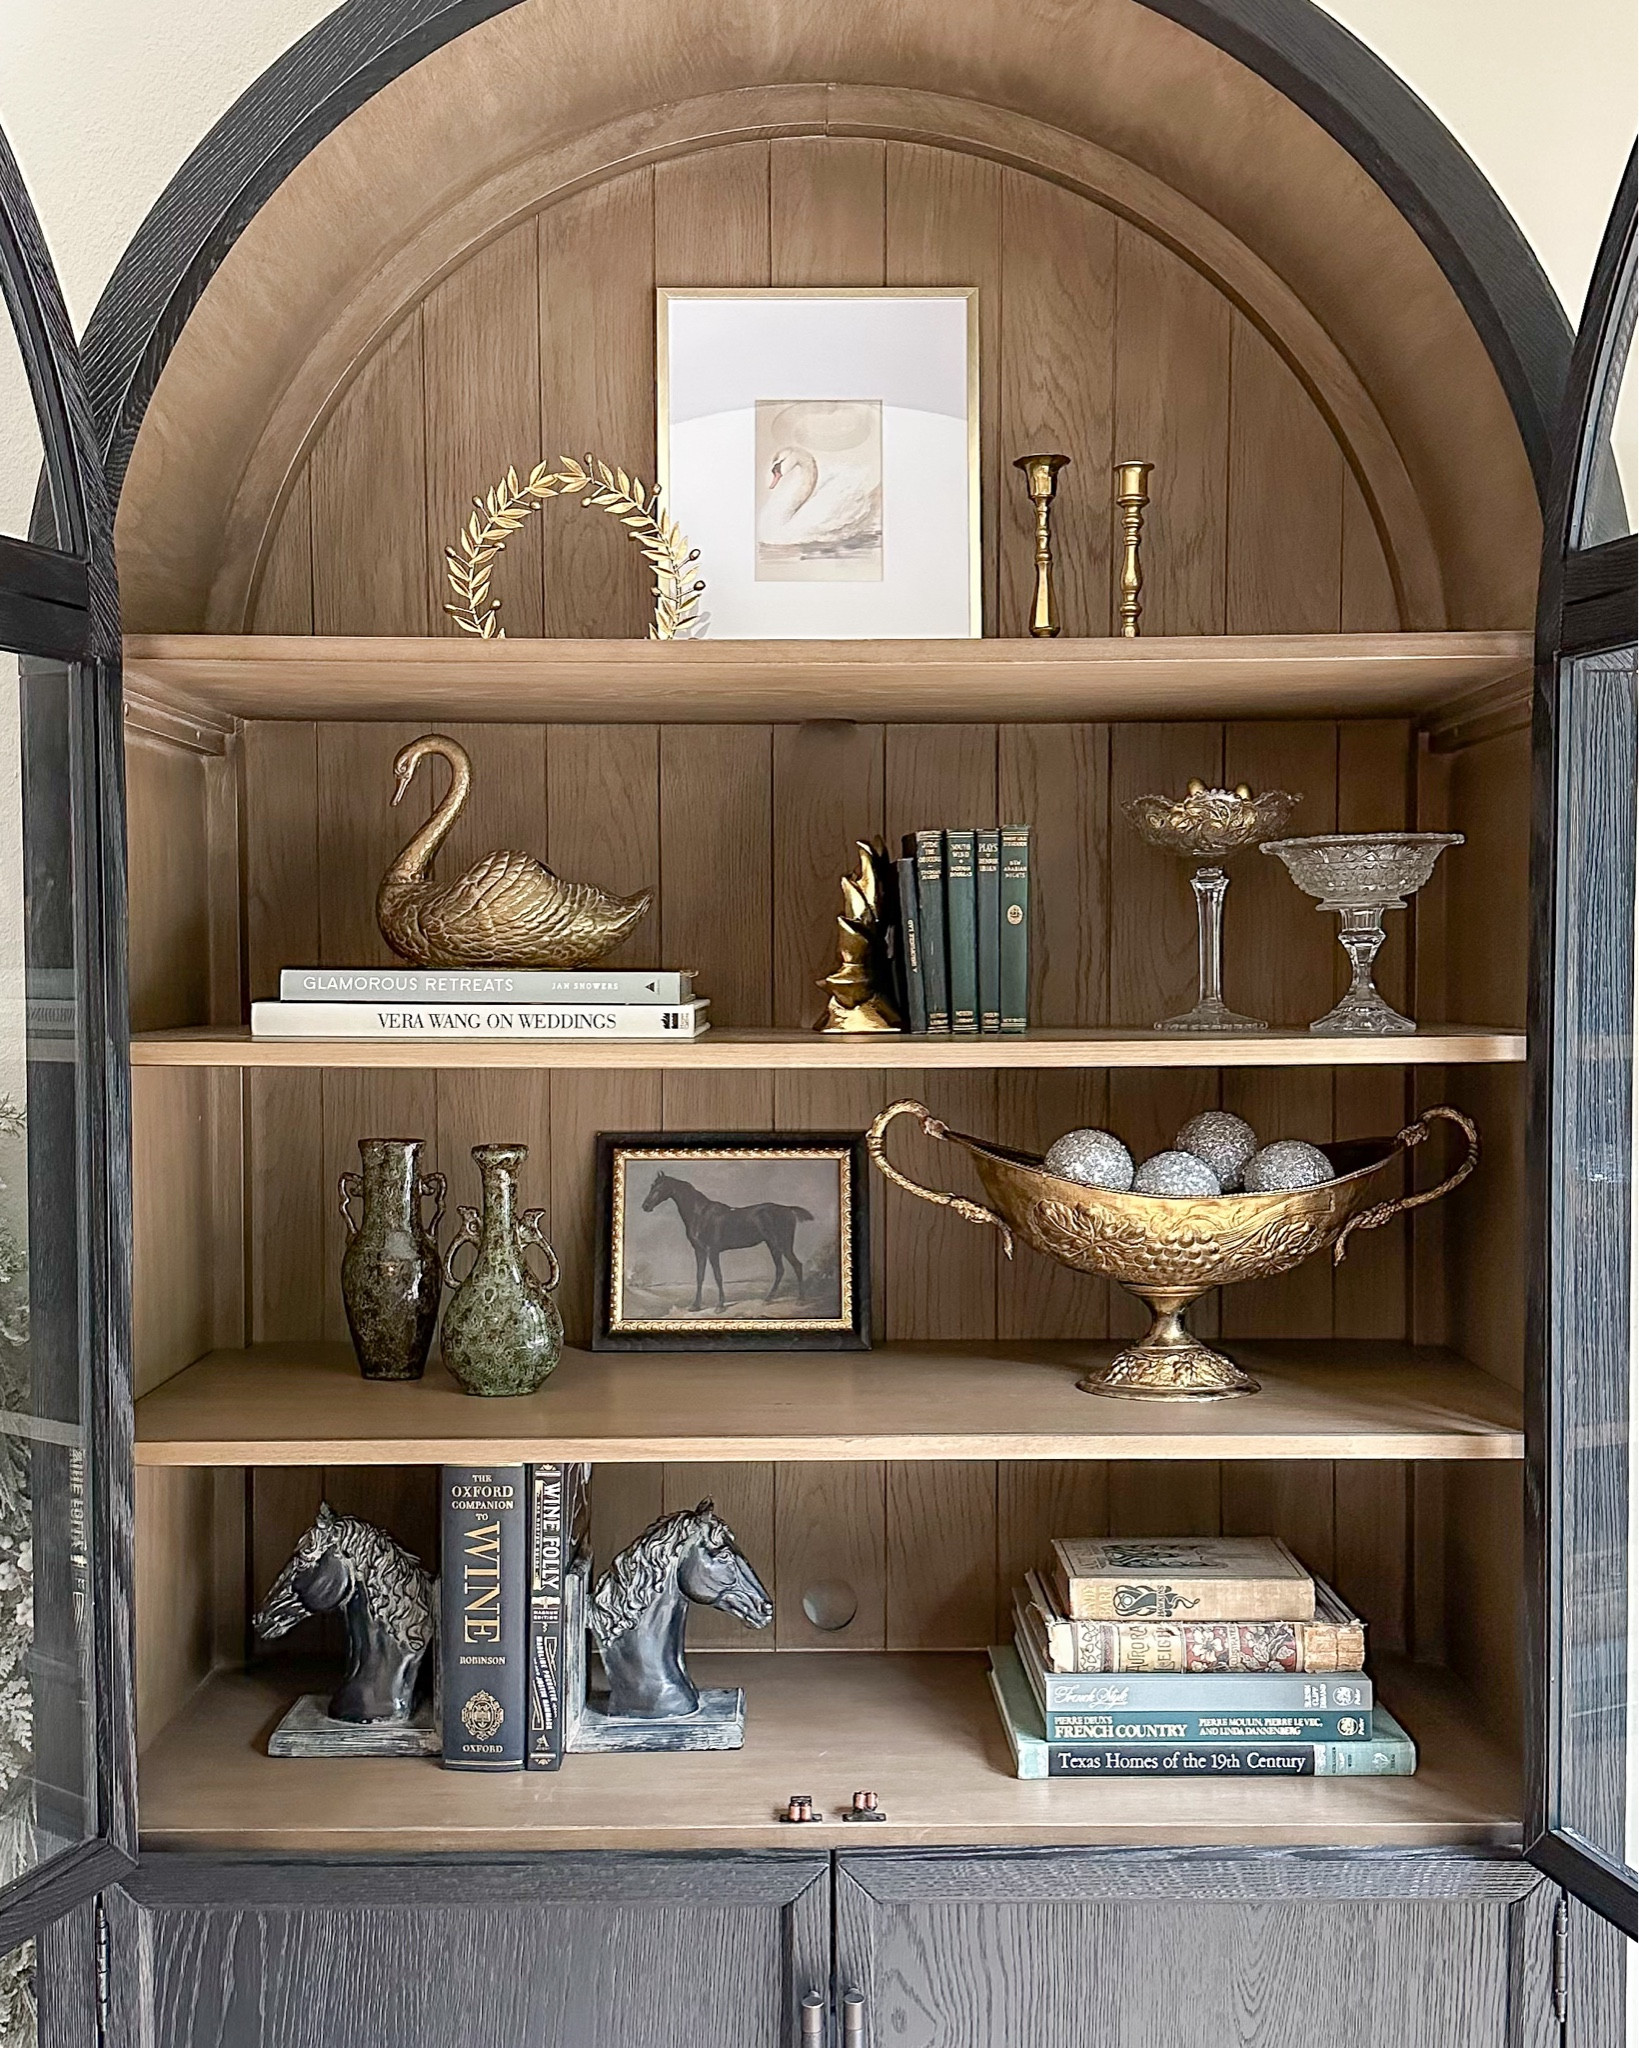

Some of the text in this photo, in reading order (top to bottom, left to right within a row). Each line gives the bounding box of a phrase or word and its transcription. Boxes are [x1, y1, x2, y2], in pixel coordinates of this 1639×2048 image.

[978, 843, 998, 852] PLAYS
[303, 976, 514, 992] GLAMOROUS RETREATS
[551, 982, 619, 990] JAN SHOWERS
[377, 1013, 617, 1029] VERA WANG ON WEDDINGS
[472, 1474, 492, 1483] THE
[451, 1485, 514, 1498] OXFORD
[451, 1500, 514, 1510] COMPANION
[476, 1512, 489, 1521] TO
[541, 1481, 562, 1591] WINE FOLLY
[464, 1520, 501, 1643] WINE
[1098, 1585, 1112, 1617] BARR
[1125, 1626, 1150, 1672] AURORA
[459, 1656, 506, 1665] ROBINSON
[1054, 1716, 1083, 1724] PIERRE
[1199, 1717, 1227, 1726] PIERRE
[1264, 1718, 1292, 1726] PIERRE
[1054, 1724, 1188, 1738] FRENCH COUNTRY
[1200, 1726, 1218, 1735] AND
[1219, 1726, 1245, 1735] LINDA
[462, 1744, 503, 1753] OXFORD
[1057, 1751, 1306, 1772] Texas Homes of the 19th Century
